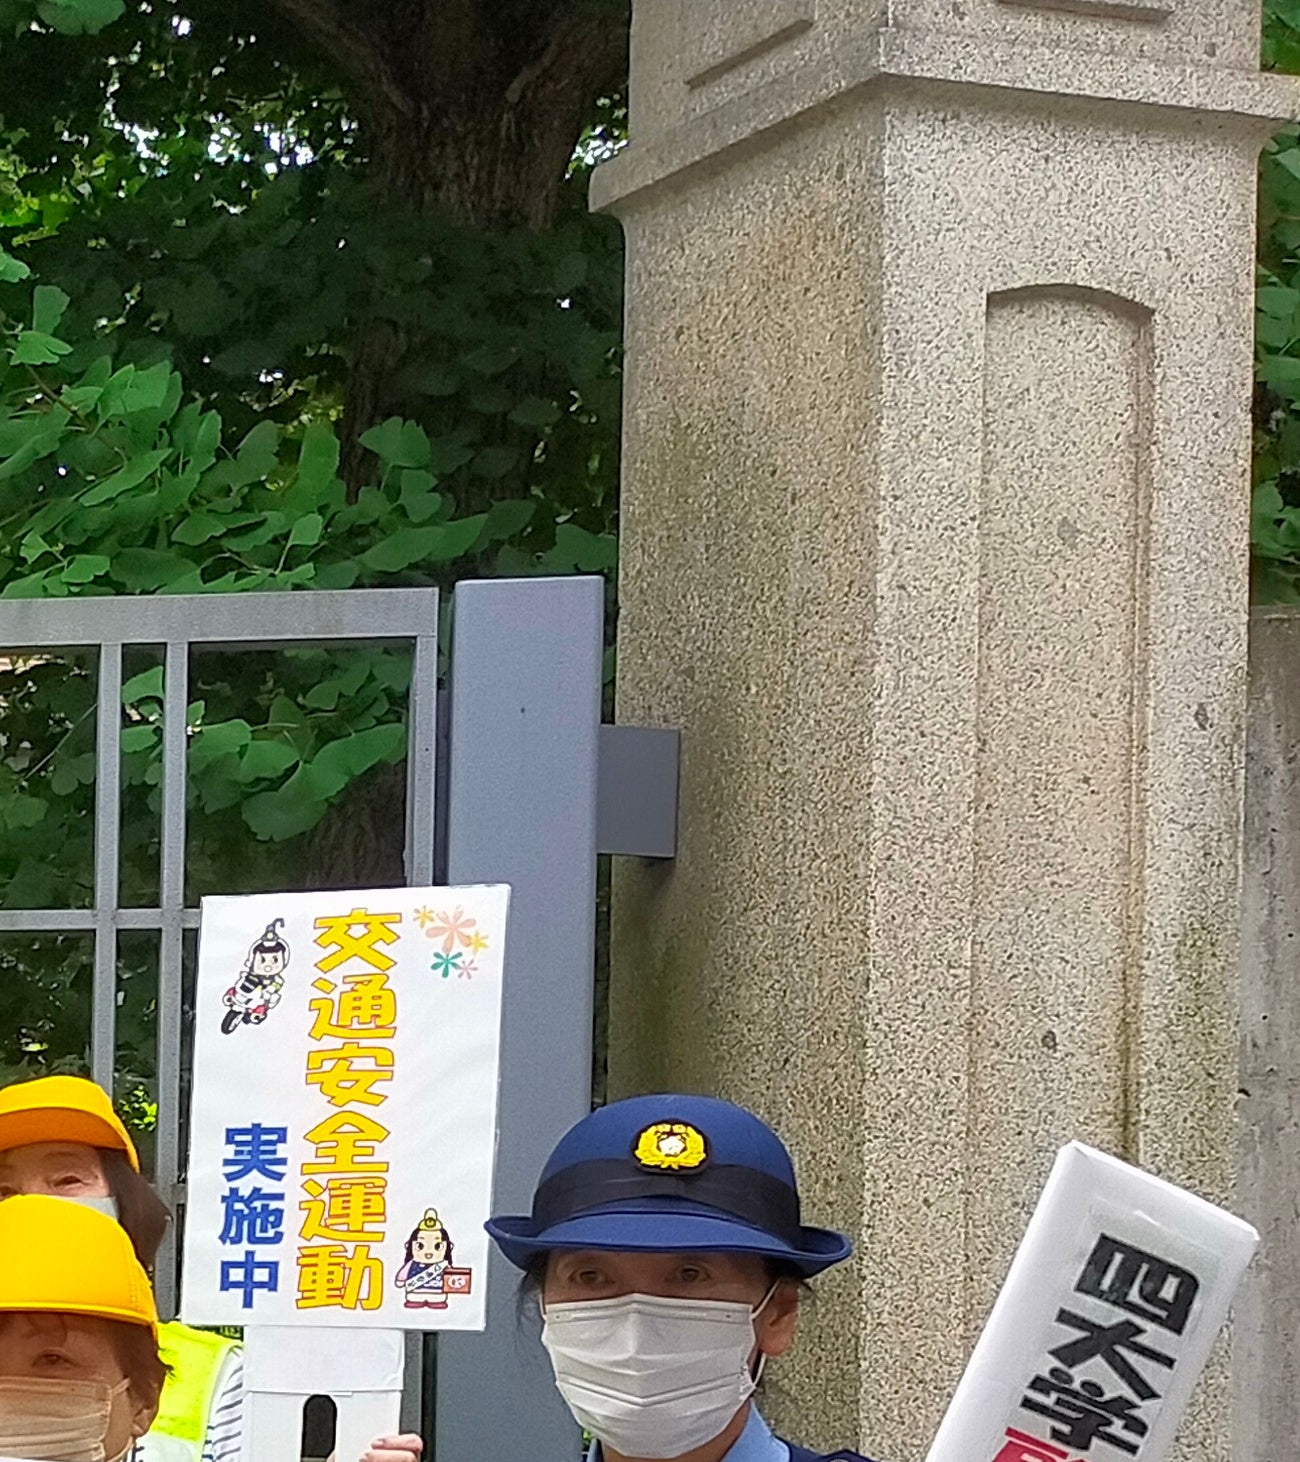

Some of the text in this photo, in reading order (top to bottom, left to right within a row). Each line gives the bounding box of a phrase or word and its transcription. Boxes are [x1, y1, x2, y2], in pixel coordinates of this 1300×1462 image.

[219, 1122, 288, 1309] 実施中
[295, 907, 403, 1311] 交通安全運動
